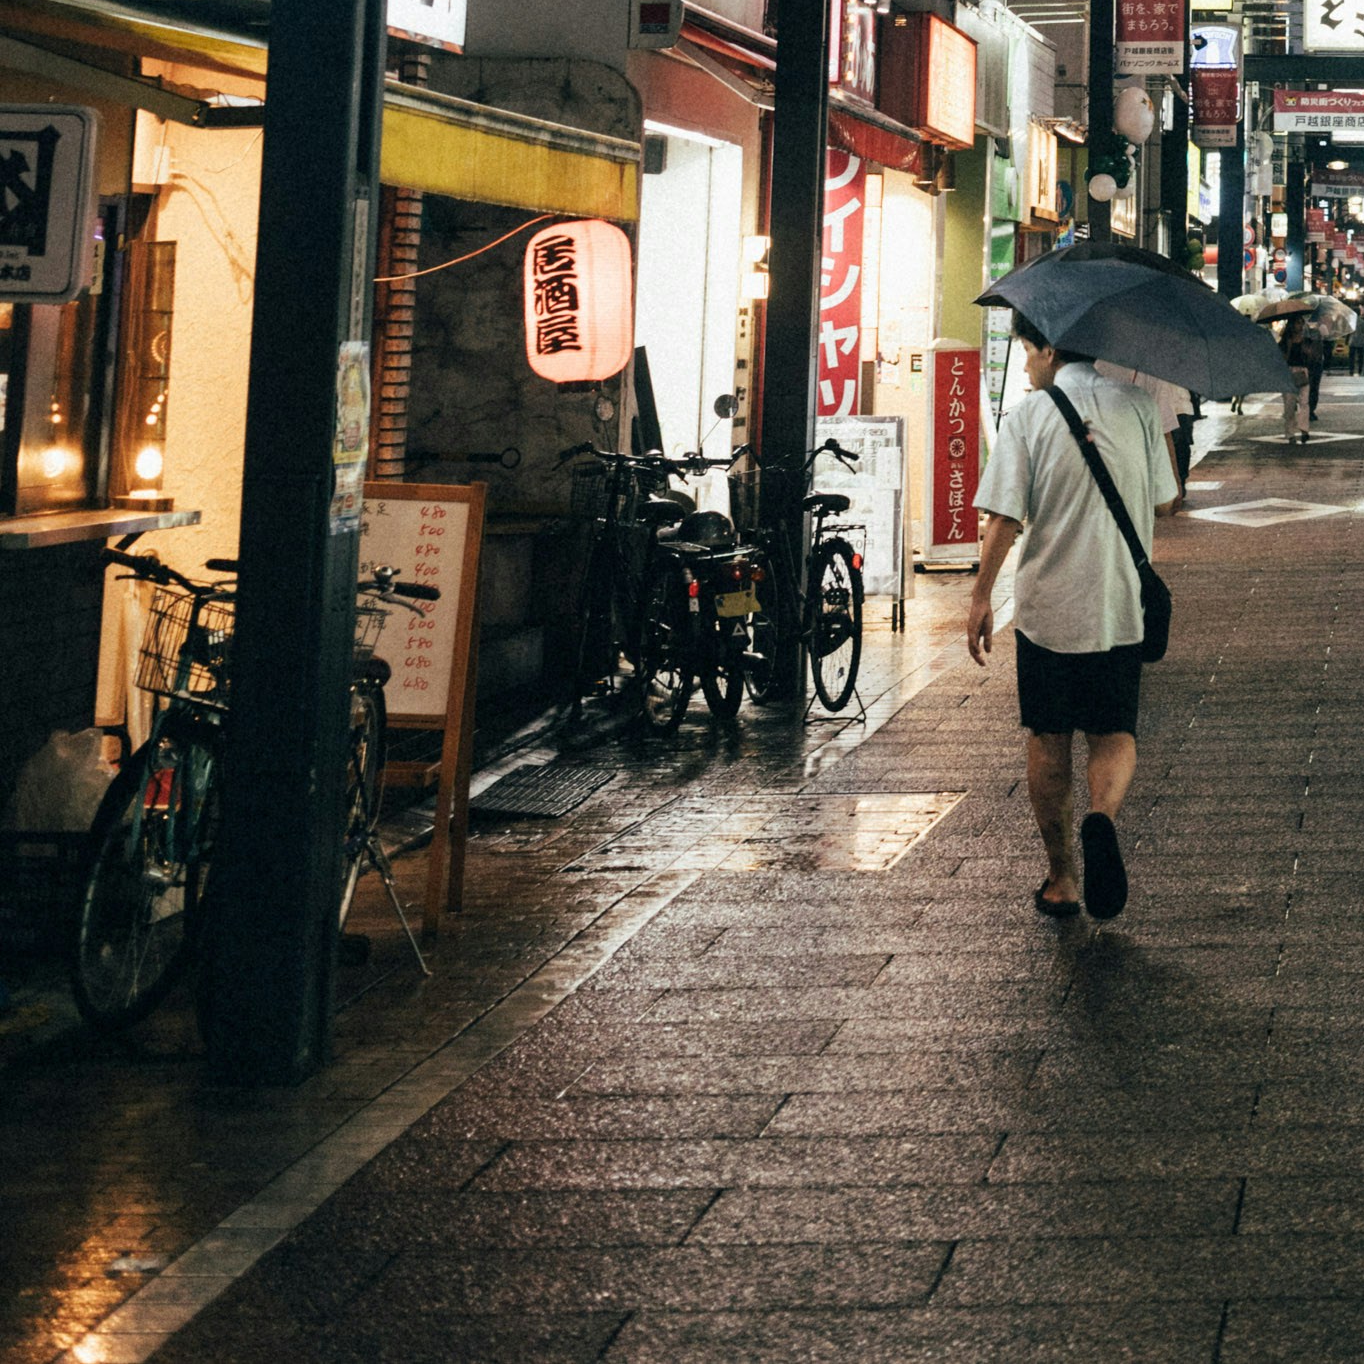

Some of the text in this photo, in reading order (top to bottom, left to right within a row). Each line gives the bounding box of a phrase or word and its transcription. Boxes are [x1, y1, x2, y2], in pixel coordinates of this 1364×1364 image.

[1122, 2, 1179, 15] 街を、家で
[1127, 19, 1174, 31] まもろう。
[948, 357, 966, 540] とんかつ さぼてん
[420, 506, 447, 519] 480
[418, 524, 446, 537] 500
[414, 563, 439, 576] 400
[407, 616, 435, 631] 600
[404, 637, 433, 650] 580
[404, 655, 432, 668] 480
[402, 676, 429, 691] 480
